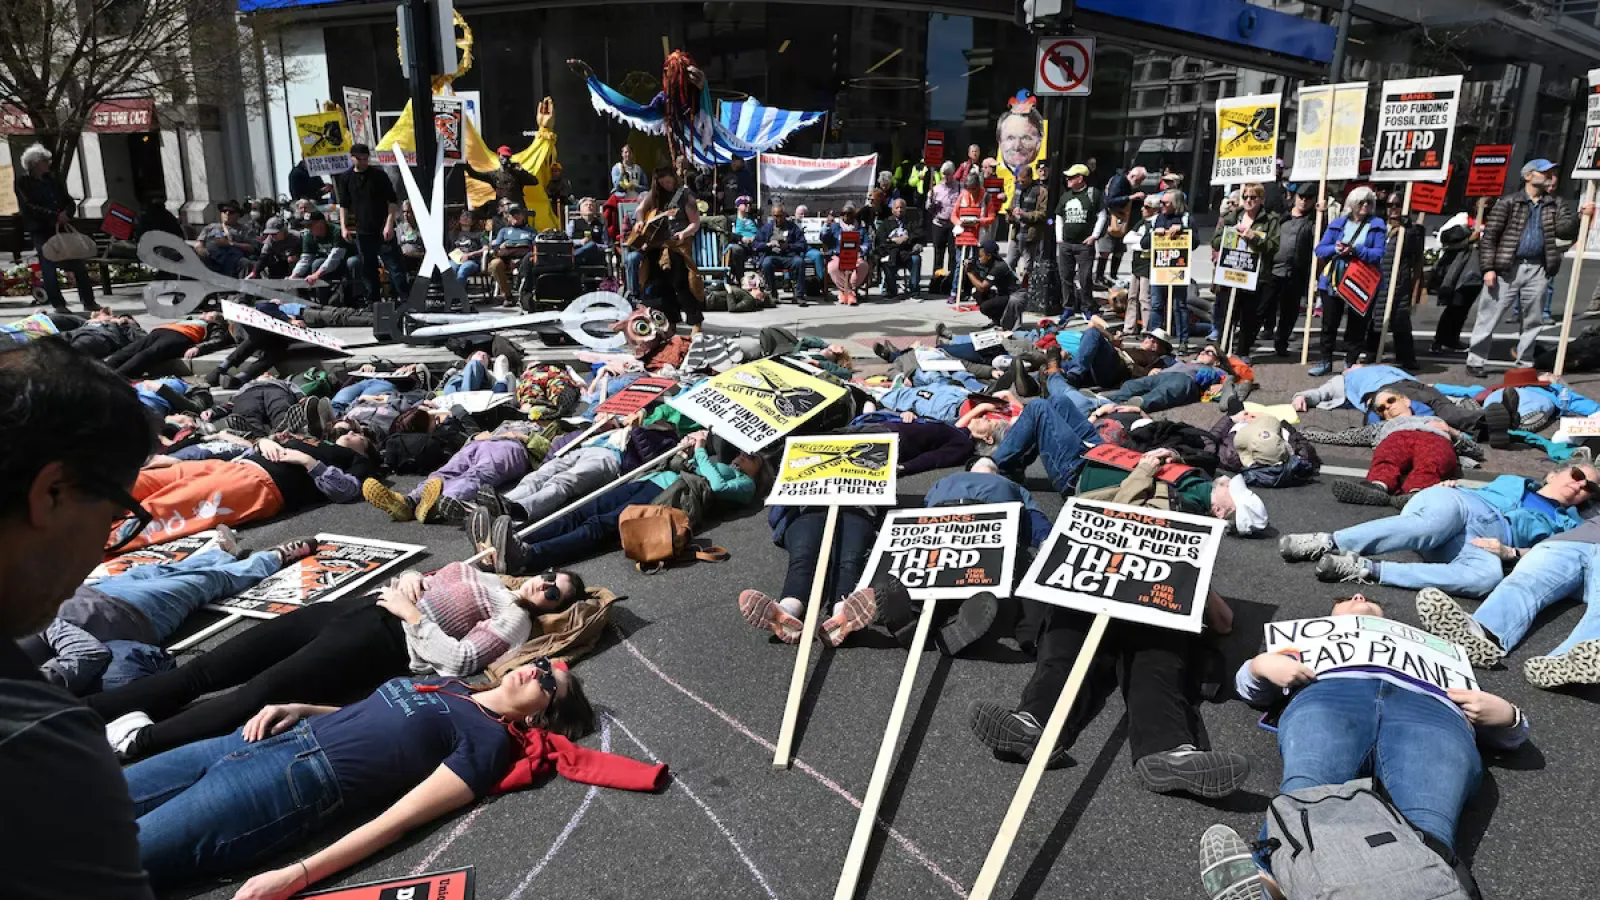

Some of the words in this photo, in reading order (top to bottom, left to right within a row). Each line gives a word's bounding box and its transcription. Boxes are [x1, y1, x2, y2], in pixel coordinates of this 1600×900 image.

[1385, 104, 1408, 114] STOP
[1411, 102, 1448, 114] FUNDING
[1385, 115, 1416, 126] FOSSIL
[1420, 114, 1448, 125] FUELS
[1217, 158, 1236, 168] STOP
[1240, 156, 1272, 166] FUNDING
[1380, 150, 1415, 169] ACT
[1216, 167, 1244, 177] FOSSIL
[1247, 165, 1271, 175] FUELS
[688, 393, 725, 419] FOSSIL
[728, 416, 765, 442] FUELS
[700, 387, 730, 405] STOP
[728, 403, 778, 437] FUNDING
[778, 488, 831, 496] FOSSIL
[837, 486, 885, 496] FUELS
[781, 480, 818, 491] STOP
[824, 477, 887, 488] FUNDING
[918, 514, 976, 524] BANKS:
[1103, 508, 1171, 528] BANKS:
[891, 526, 930, 536] STOP
[934, 522, 1002, 535] FUNDING
[1071, 510, 1116, 530] STOP
[1121, 522, 1202, 545] FUNDING
[890, 535, 946, 547] FOSSIL
[951, 534, 1001, 546] FUELS
[1068, 521, 1133, 549] FOSSIL
[1138, 539, 1200, 561] FUELS
[890, 547, 980, 569] TH!RD
[1066, 540, 1172, 582] TH!RD
[1046, 562, 1126, 597] ACT
[1153, 583, 1174, 593] OUR
[1151, 590, 1174, 601] TIME
[1138, 595, 1149, 604] IS
[1151, 596, 1182, 611] NOW!
[1269, 619, 1336, 645] NO
[1327, 632, 1360, 641] ON
[1381, 635, 1396, 645] A
[1299, 641, 1356, 671] EAD
[1368, 640, 1477, 691] PLANET
[396, 887, 416, 900] D
